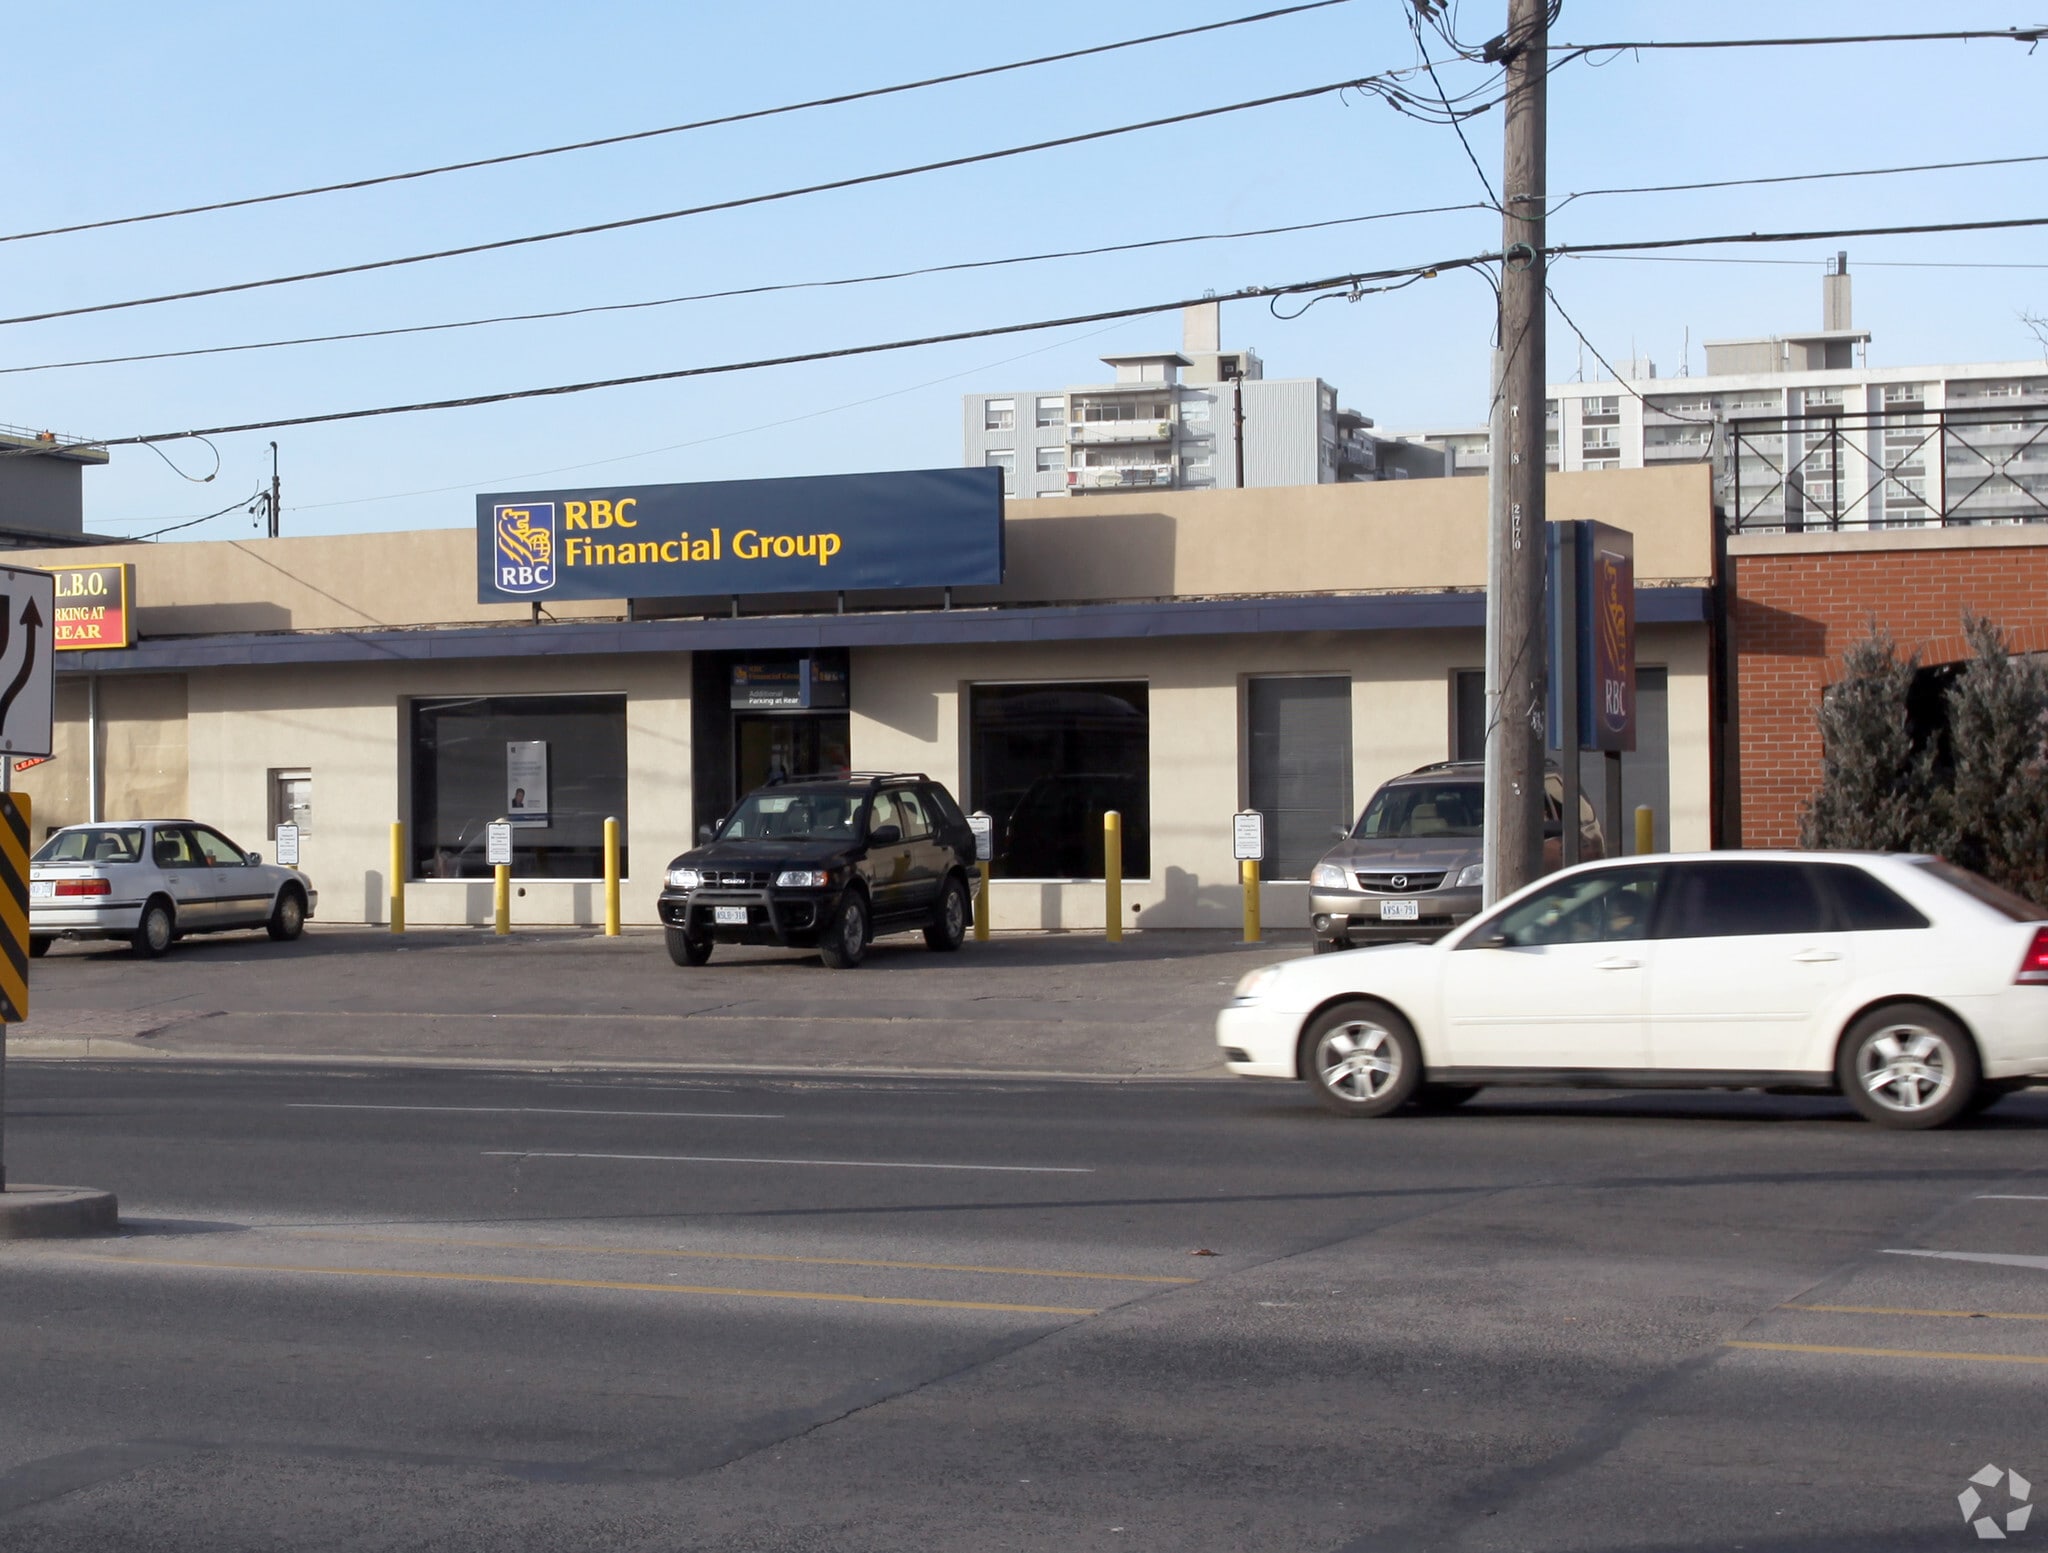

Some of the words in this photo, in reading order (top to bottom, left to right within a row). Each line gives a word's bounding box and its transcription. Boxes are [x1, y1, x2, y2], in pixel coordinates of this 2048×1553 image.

[564, 498, 637, 530] RBC
[565, 527, 721, 567] Financial
[732, 529, 841, 566] Group
[502, 565, 549, 586] RBC
[55, 606, 89, 622] RKING
[91, 606, 105, 620] AT
[749, 698, 774, 706] Parking
[783, 697, 799, 705] Rear
[1605, 679, 1626, 717] RBC
